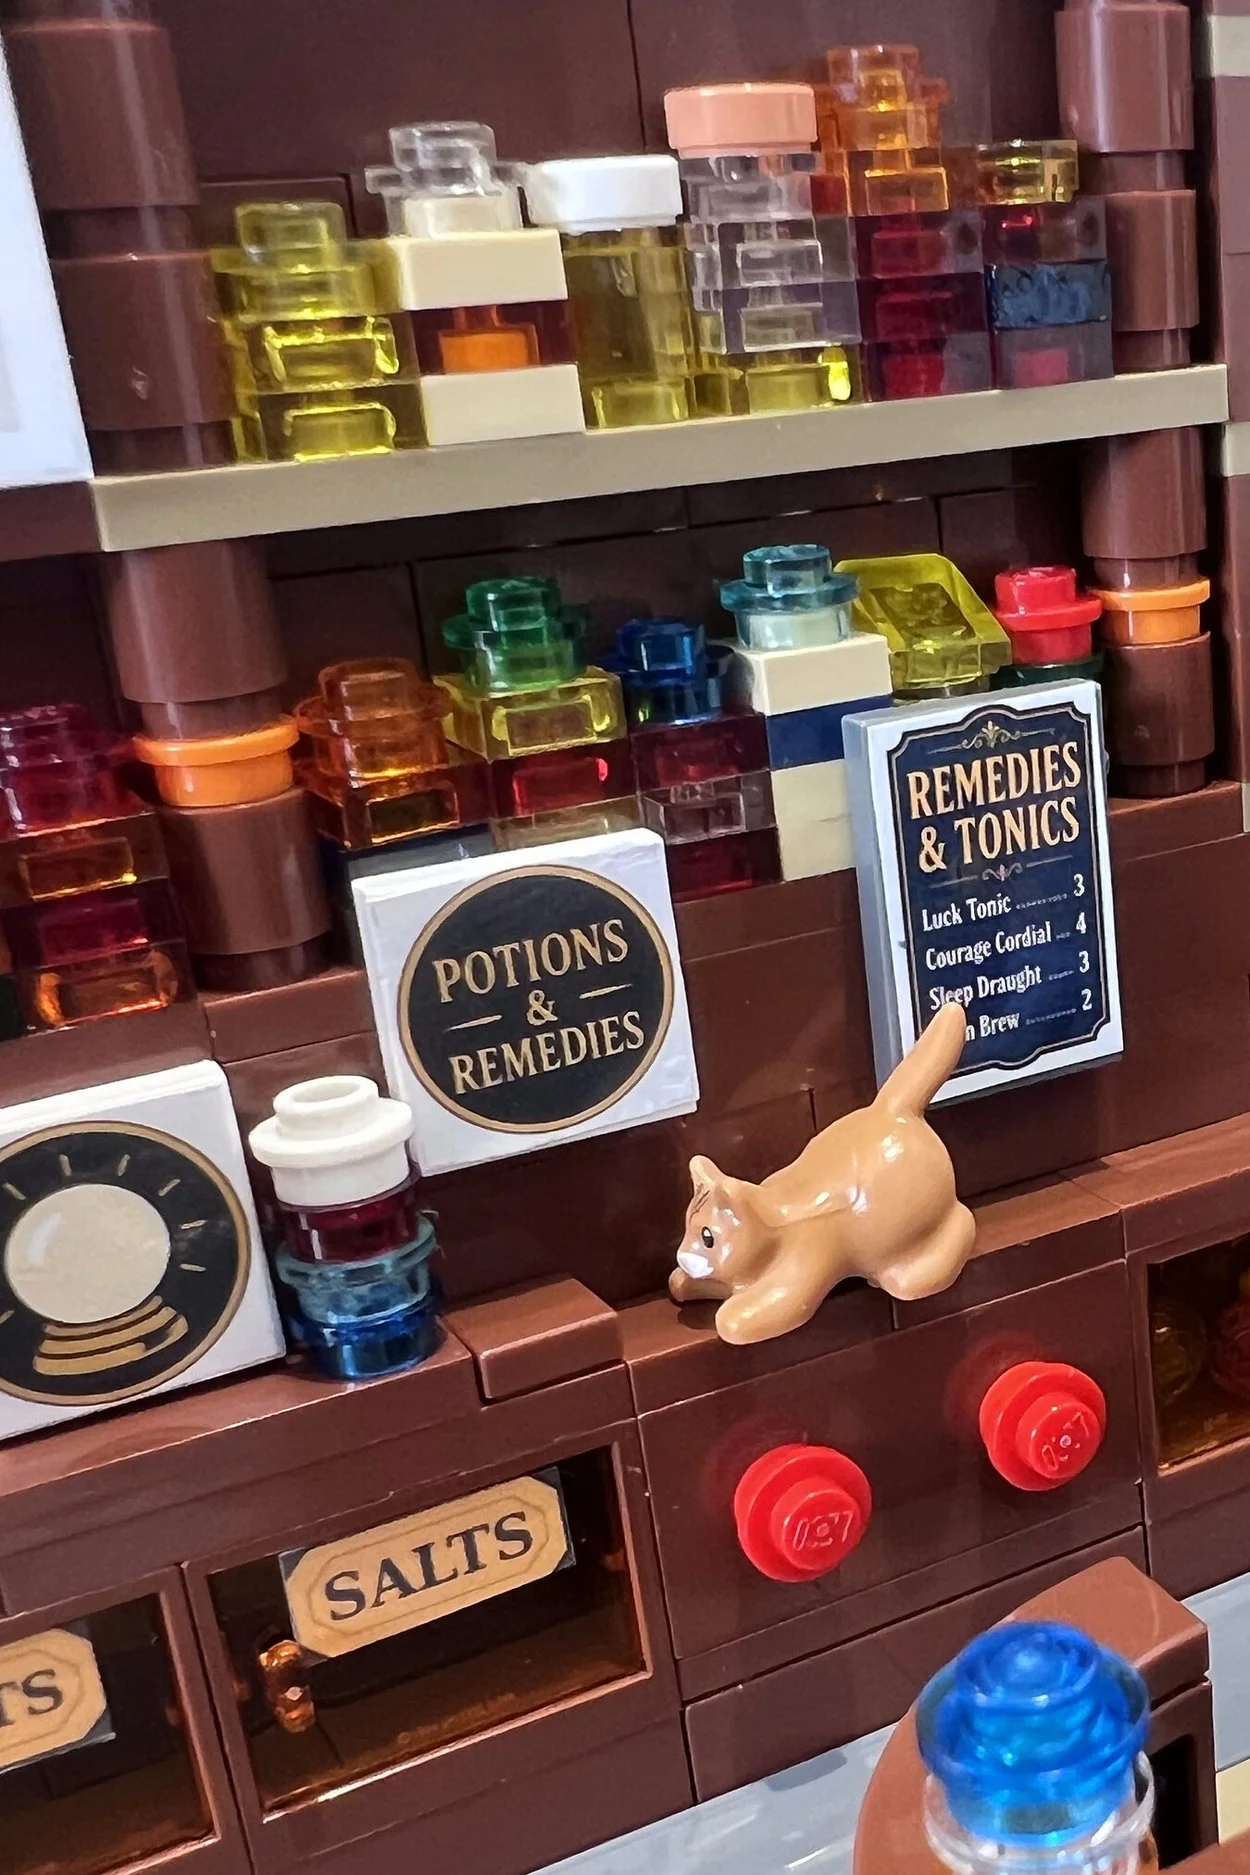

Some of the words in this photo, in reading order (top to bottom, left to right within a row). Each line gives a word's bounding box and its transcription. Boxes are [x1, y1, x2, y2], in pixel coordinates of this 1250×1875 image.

[907, 741, 1081, 820] REMEDIES
[918, 825, 947, 873] &
[954, 796, 1080, 865] TONICS
[922, 903, 963, 932] Luck
[965, 893, 1012, 922] Tonic
[1073, 873, 1085, 897] 3
[432, 918, 629, 1003] POTIONS
[925, 939, 992, 971] Courage
[995, 921, 1053, 954] Cordial
[1075, 912, 1087, 934] 4
[526, 989, 559, 1026] &
[929, 985, 974, 1011] Sleep
[977, 964, 1043, 999] Draught
[1078, 950, 1090, 973] 3
[979, 1012, 1020, 1038] Brew
[1081, 988, 1093, 1011] 2
[449, 1010, 646, 1095] REMEDIES
[323, 1511, 533, 1620] SALTS
